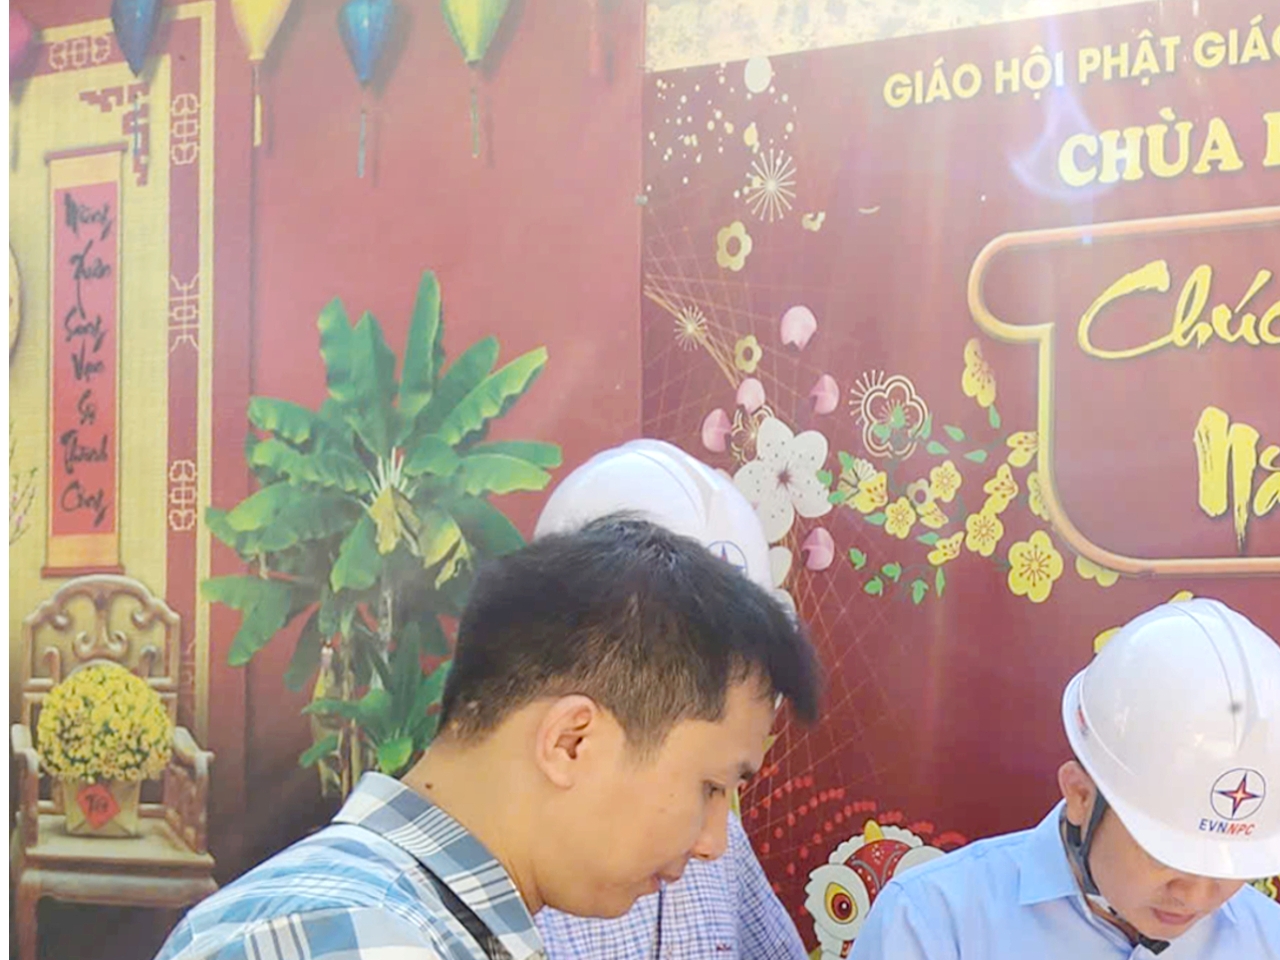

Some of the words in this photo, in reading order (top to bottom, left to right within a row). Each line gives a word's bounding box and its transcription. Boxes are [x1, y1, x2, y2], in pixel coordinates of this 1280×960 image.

[883, 56, 982, 108] GIÁO
[995, 44, 1064, 100] HỘI
[1078, 28, 1181, 86] PHẬT
[1058, 106, 1244, 187] CHÙA
